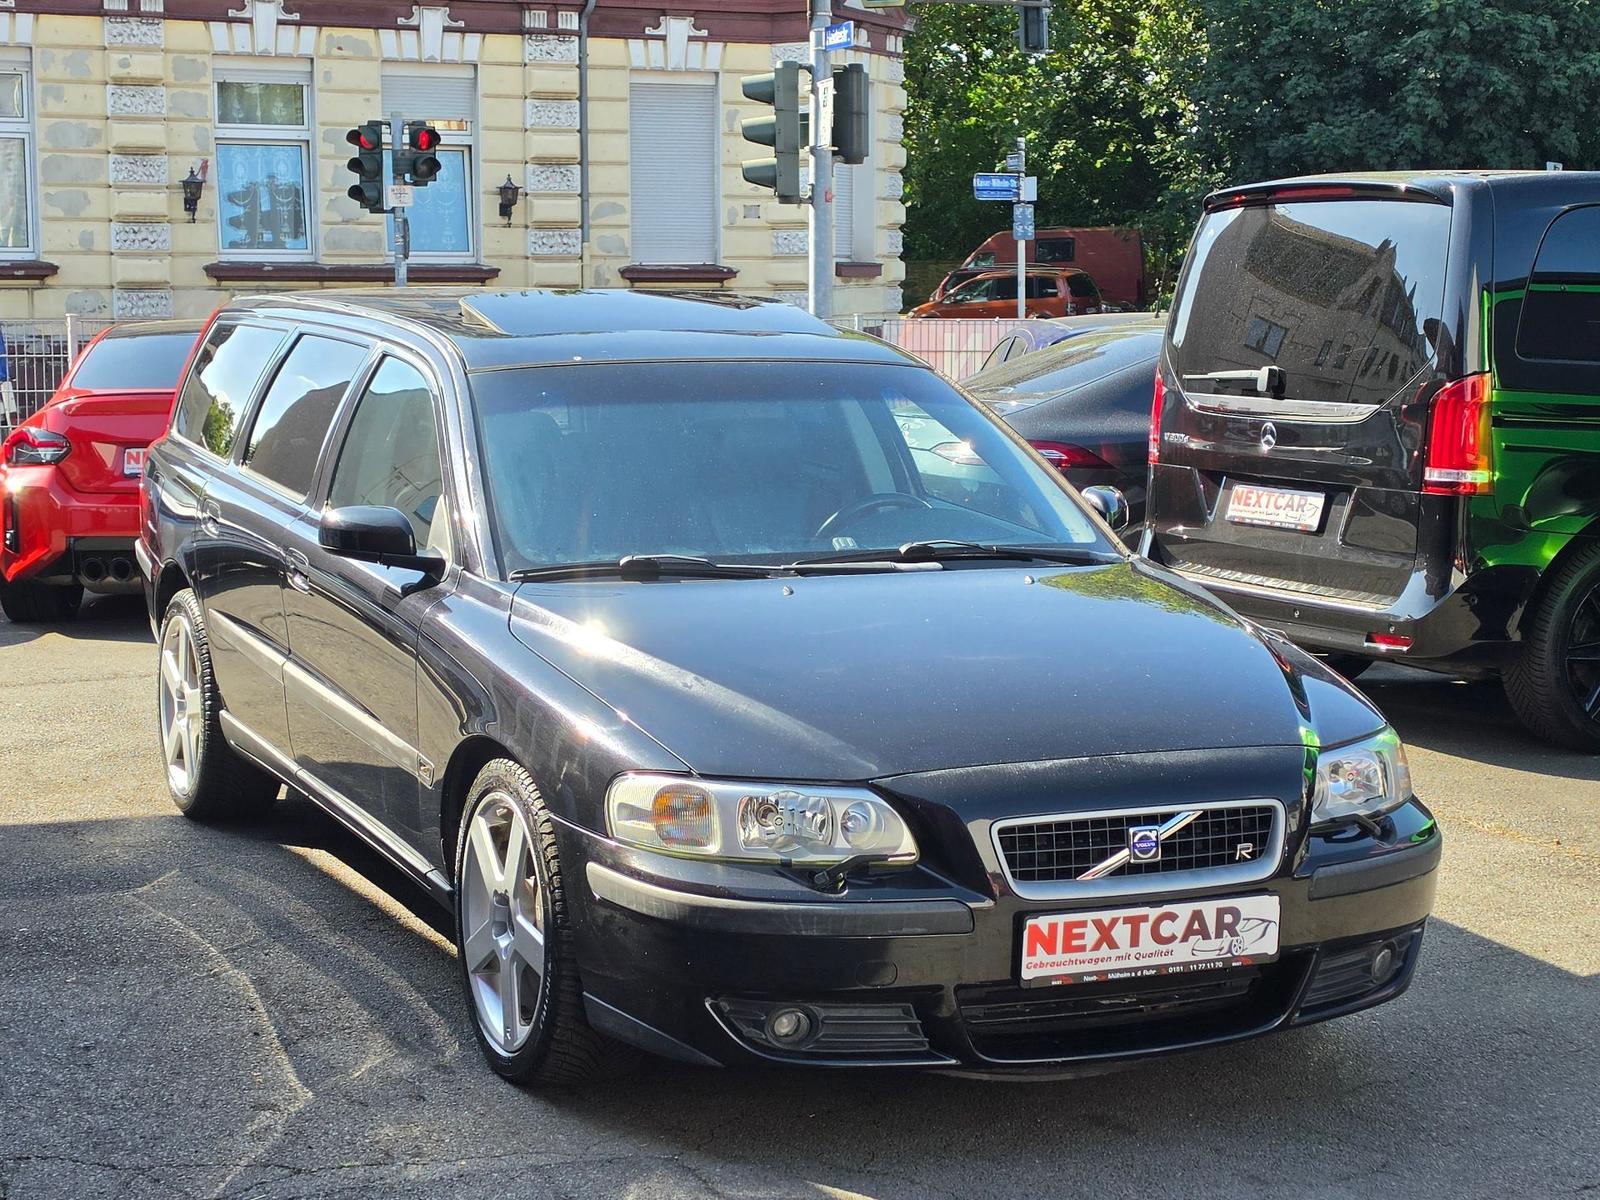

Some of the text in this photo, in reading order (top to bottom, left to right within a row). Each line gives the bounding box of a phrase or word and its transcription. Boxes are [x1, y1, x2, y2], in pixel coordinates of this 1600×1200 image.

[1231, 488, 1308, 513] NEXTCAR
[1235, 842, 1253, 860] R
[1026, 906, 1242, 957] NEXTCAR
[1026, 949, 1174, 970] Gebrauchtwagen mit Qualität
